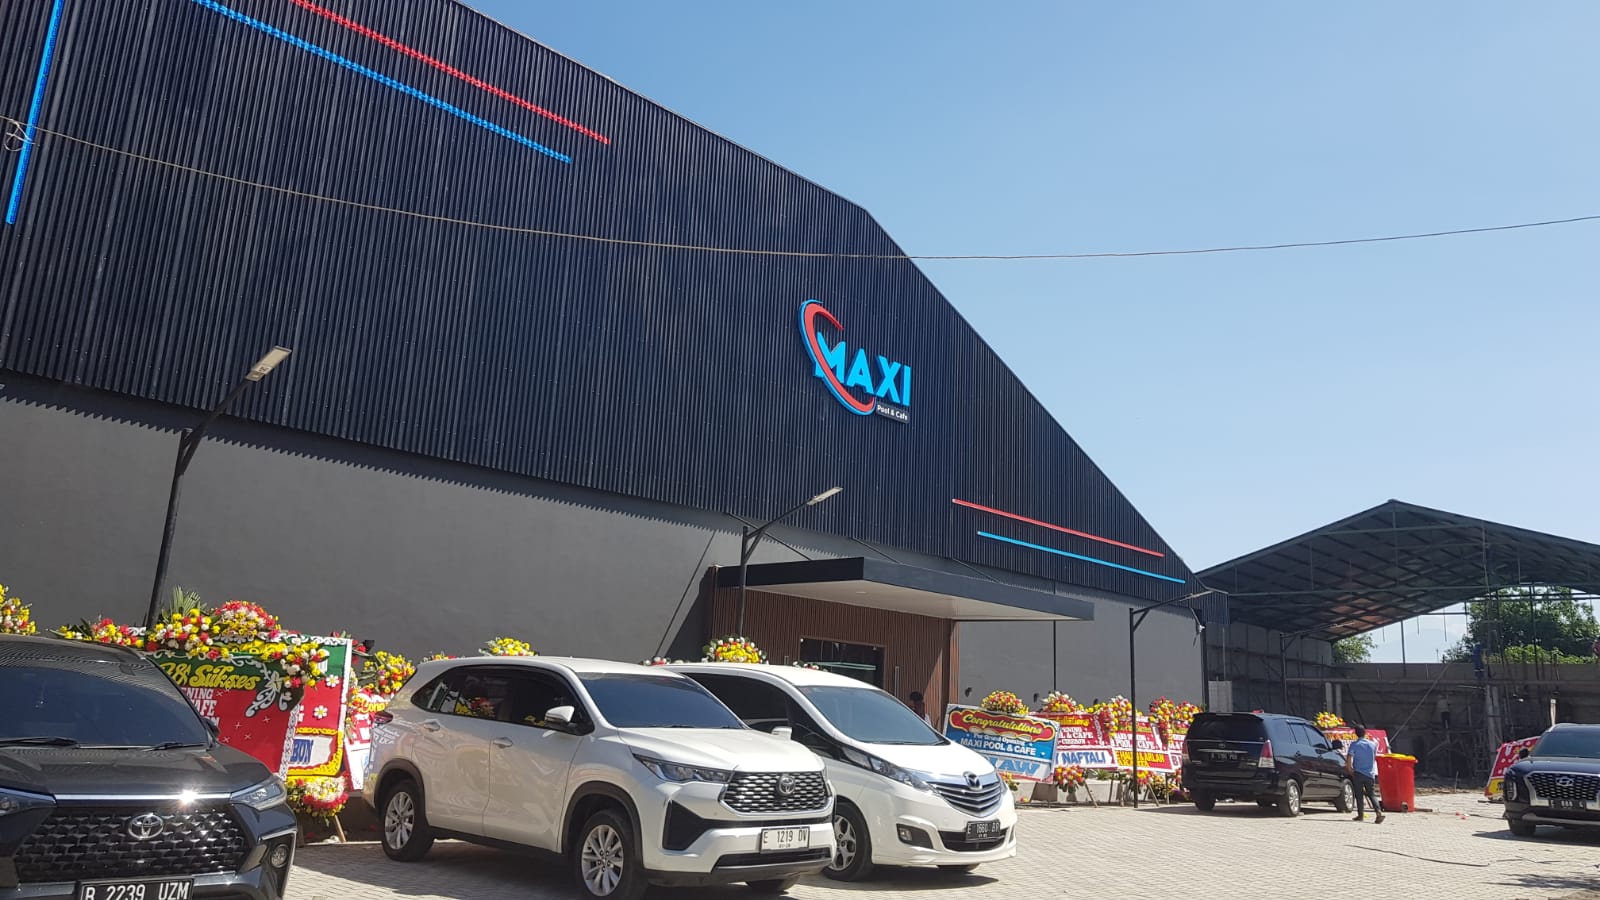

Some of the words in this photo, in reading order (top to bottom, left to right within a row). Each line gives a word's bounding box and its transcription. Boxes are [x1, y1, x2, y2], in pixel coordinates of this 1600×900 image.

[815, 331, 911, 406] MAXI
[877, 404, 890, 415] Pool
[896, 411, 908, 421] Cafe
[189, 664, 260, 690] Sukses
[182, 687, 214, 700] NING
[193, 699, 217, 716] AFE
[963, 714, 1042, 734] Congratulations
[960, 738, 982, 748] MAXI
[983, 741, 1005, 751] POOL
[1006, 743, 1014, 752] &
[1014, 745, 1037, 755] CAFE
[1061, 751, 1106, 764] NAFTALI
[763, 831, 769, 844] E
[777, 830, 793, 843] 1219
[106, 884, 146, 900] 2239
[159, 882, 190, 900] UZM
